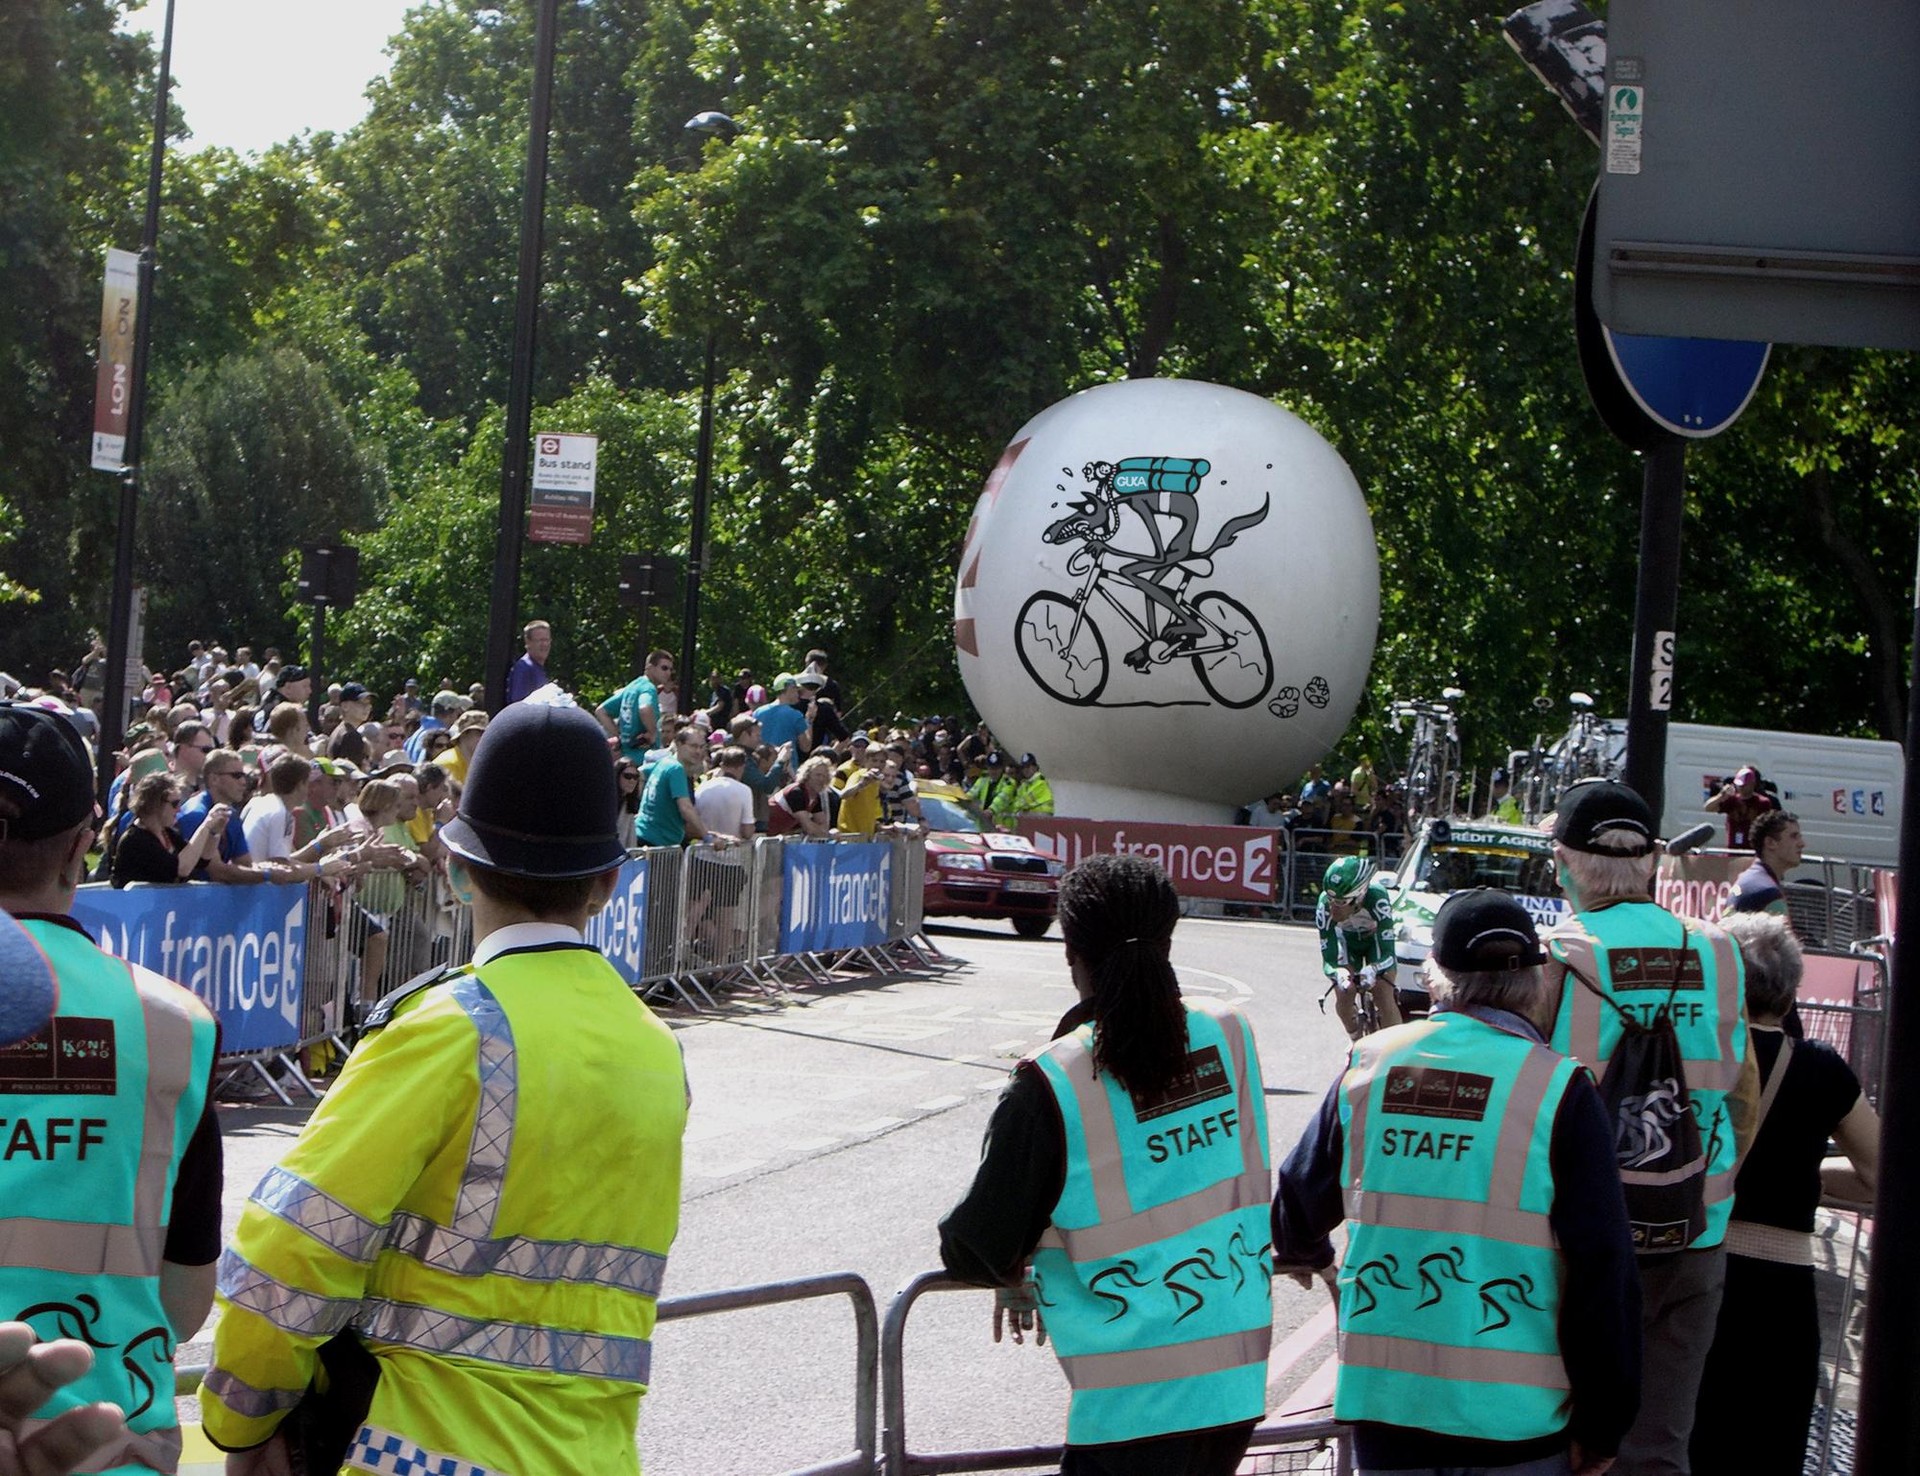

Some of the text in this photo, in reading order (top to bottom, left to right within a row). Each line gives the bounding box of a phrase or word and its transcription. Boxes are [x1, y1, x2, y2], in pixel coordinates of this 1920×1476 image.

[539, 458, 591, 471] Bus stand
[1659, 677, 1671, 704] 2
[1451, 831, 1495, 844] RÉDIT
[1242, 835, 1273, 896] 2
[828, 857, 878, 925] france
[161, 910, 281, 1011] france
[1146, 1108, 1238, 1164] STAFF
[1382, 1128, 1475, 1162] STAFF
